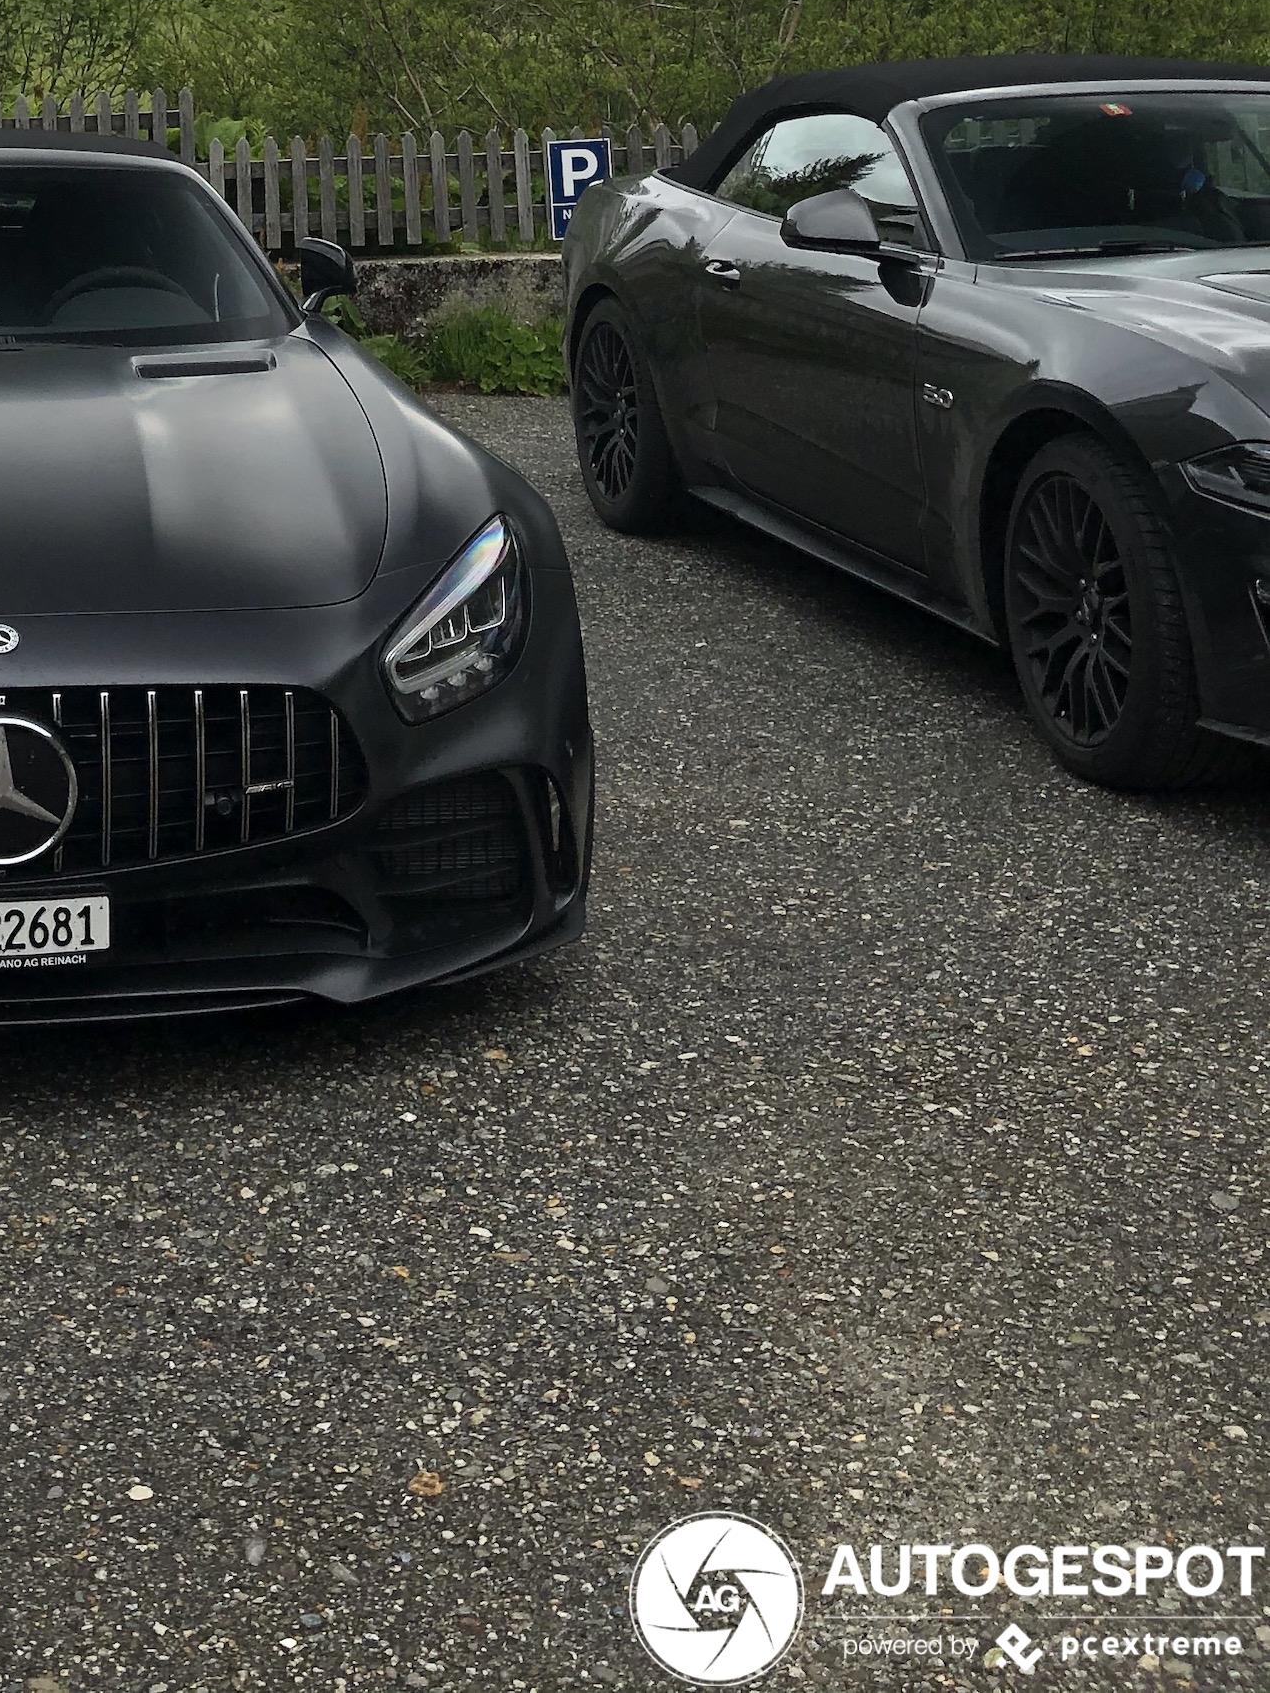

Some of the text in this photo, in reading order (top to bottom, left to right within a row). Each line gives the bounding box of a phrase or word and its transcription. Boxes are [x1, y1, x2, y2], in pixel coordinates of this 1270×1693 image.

[561, 148, 598, 197] P
[24, 957, 39, 968] AG
[40, 954, 87, 967] REINACH
